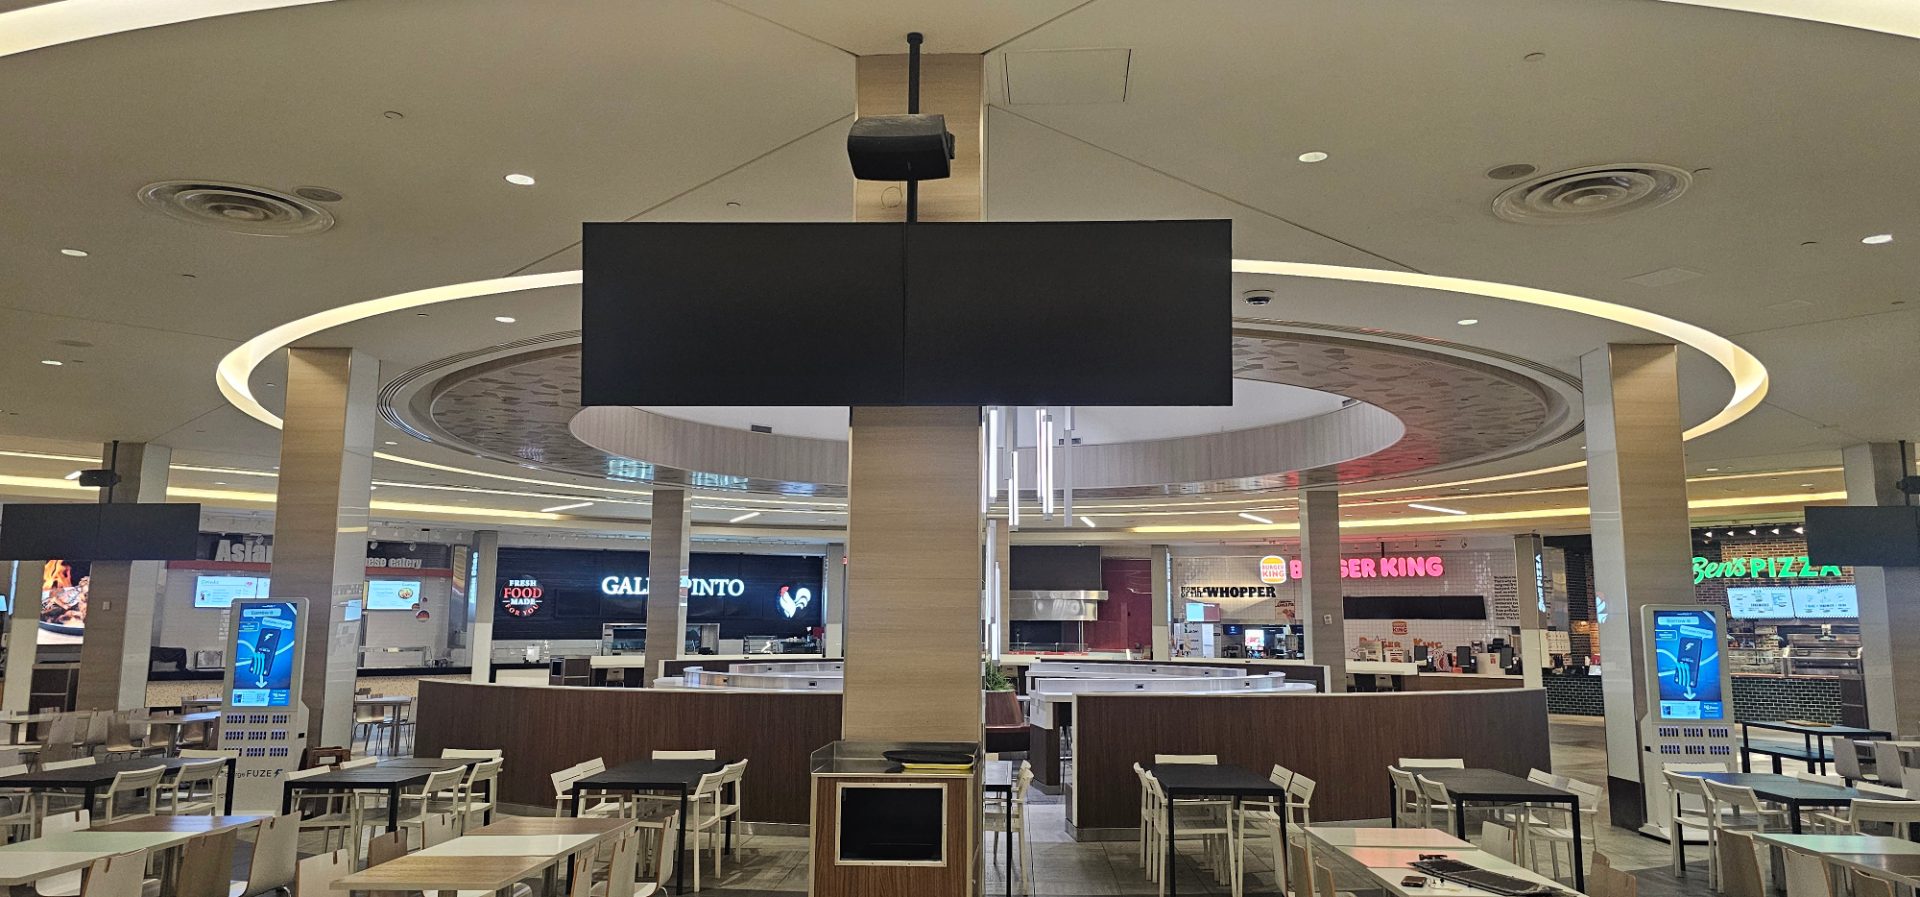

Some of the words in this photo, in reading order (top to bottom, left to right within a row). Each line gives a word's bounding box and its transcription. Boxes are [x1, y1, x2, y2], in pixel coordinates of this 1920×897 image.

[366, 557, 387, 568] ese
[388, 557, 422, 570] eatery
[1380, 556, 1444, 577] KING
[1262, 570, 1285, 578] KING
[1692, 557, 1746, 584] Ben's
[509, 579, 537, 587] FRESH
[601, 575, 650, 595] GAL
[503, 587, 543, 599] FOOD
[1203, 586, 1277, 598] WHOPPER
[504, 603, 520, 616] FOR
[522, 604, 539, 616] YOU
